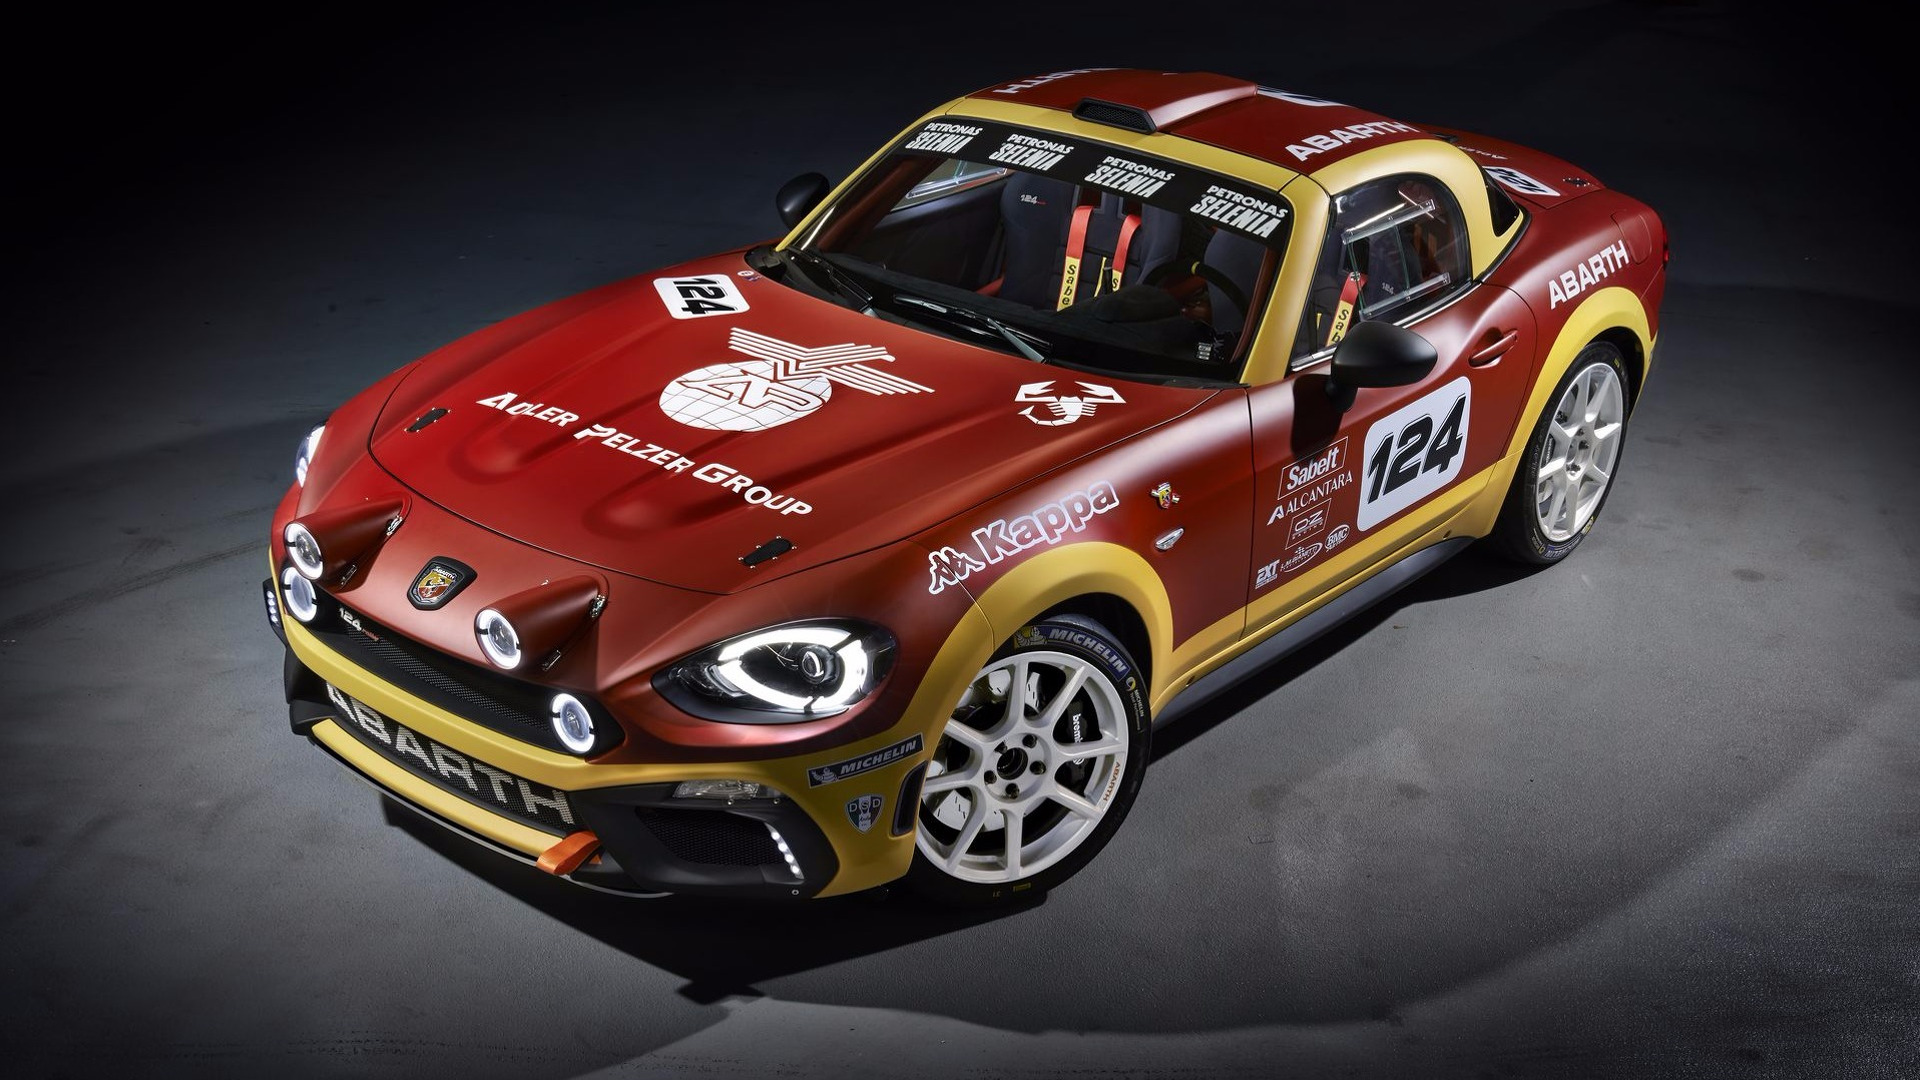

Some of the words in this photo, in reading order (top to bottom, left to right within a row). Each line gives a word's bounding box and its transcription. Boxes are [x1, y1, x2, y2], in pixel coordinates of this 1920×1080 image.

[905, 131, 974, 154] SELENIA
[924, 123, 983, 136] PETRONAS
[1007, 134, 1074, 154] PETRONAS
[1285, 121, 1420, 162] ABARTH
[989, 142, 1065, 171] SELENIA
[1103, 156, 1176, 181] PETRONAS
[1084, 165, 1167, 198] SELENIA
[1190, 196, 1281, 239] SELENIA
[1206, 185, 1289, 218] PETRONAS
[1548, 240, 1629, 310] ABARTH
[673, 277, 737, 315] 124
[1367, 392, 1467, 505] 124
[572, 423, 695, 473] PELZER
[692, 463, 814, 518] GROUP
[1287, 446, 1340, 490] Sabelt
[1286, 470, 1353, 516] ALCANTARA
[971, 480, 1120, 565] Kappa
[1327, 528, 1348, 546] BMC
[339, 607, 362, 631] 124
[1049, 627, 1127, 676] MICHELIN
[1134, 690, 1144, 717] MICHELIN
[1073, 713, 1083, 743] brem
[326, 681, 575, 825] ABARTH
[840, 740, 917, 775] MICHELIN
[1103, 761, 1121, 802] ABARTH
